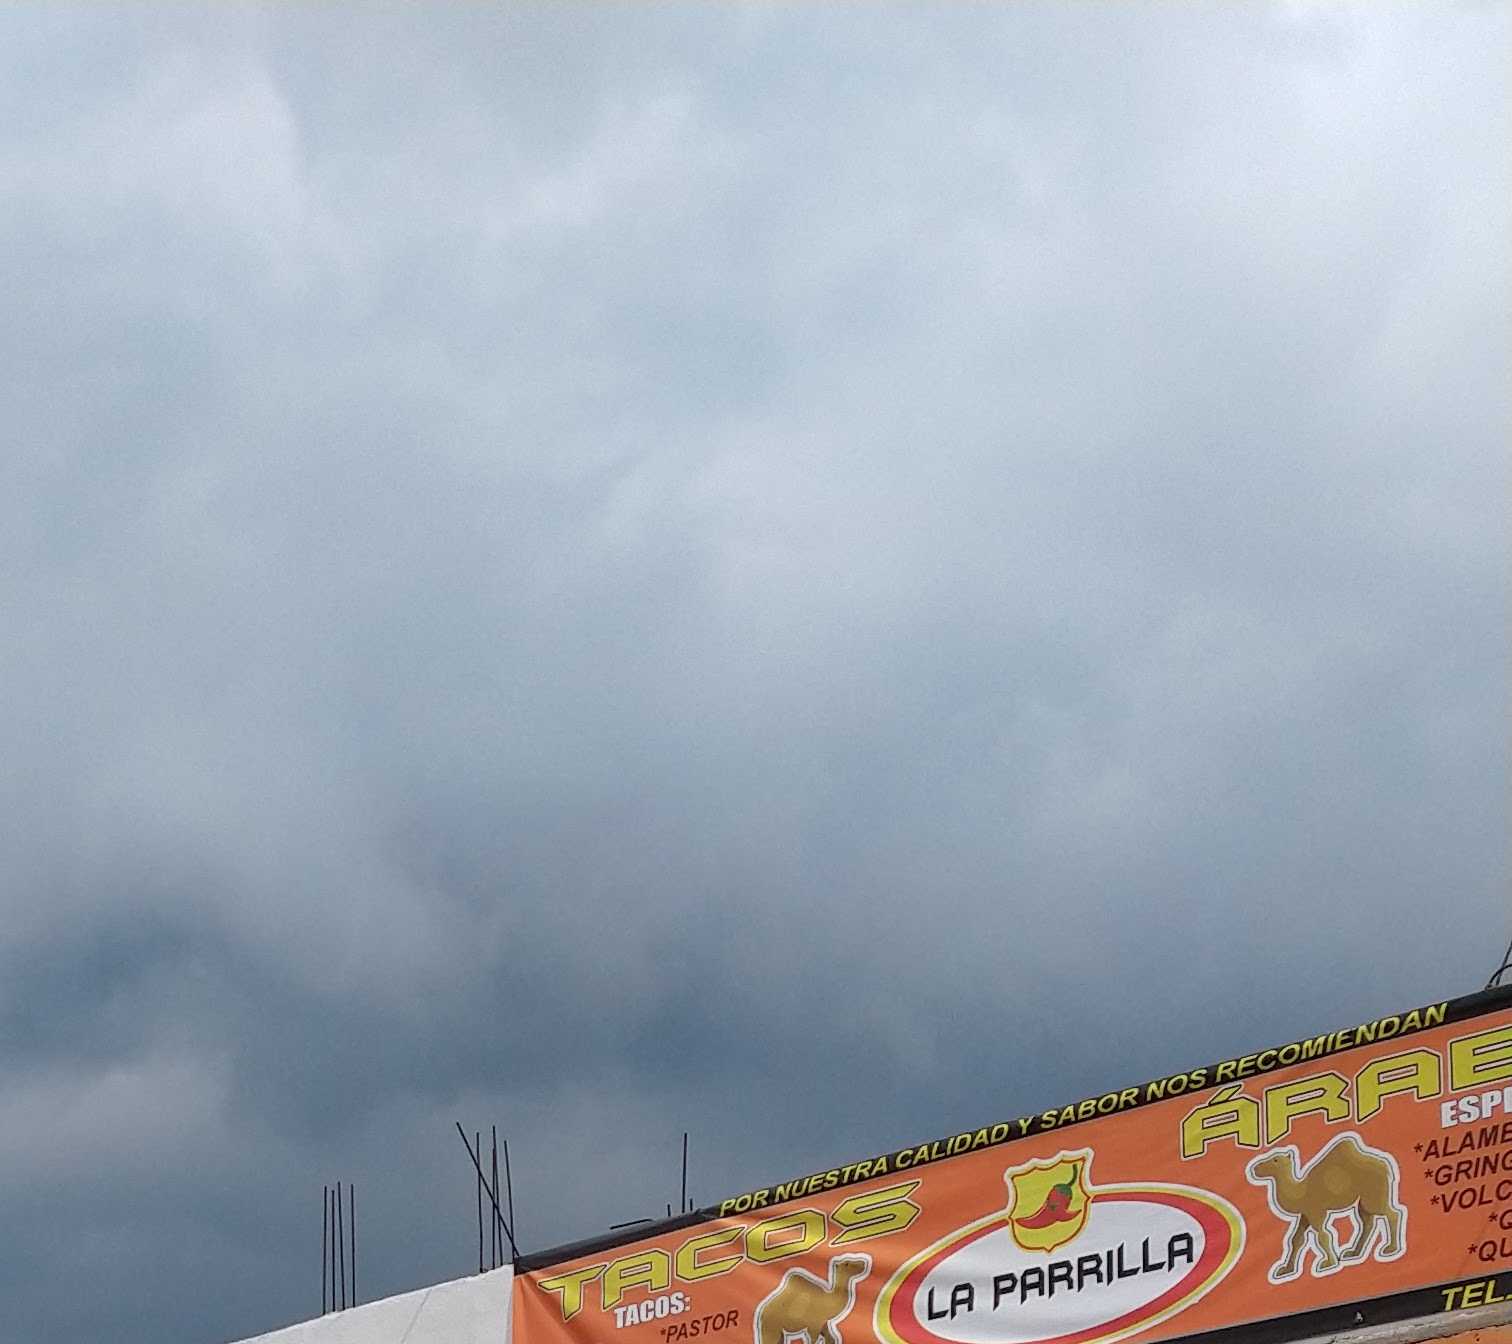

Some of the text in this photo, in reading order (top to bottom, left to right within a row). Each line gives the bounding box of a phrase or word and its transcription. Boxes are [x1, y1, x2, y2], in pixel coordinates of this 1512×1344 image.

[719, 1003, 1448, 1218] POR NUESTRA CALIDAD Y SABOR NOS RECOMIENDAN
[1441, 1087, 1512, 1128] ESP
[537, 1179, 922, 1321] TACOS
[927, 1232, 1194, 1321] LA PARRILLA
[614, 1292, 691, 1329] TACOS:
